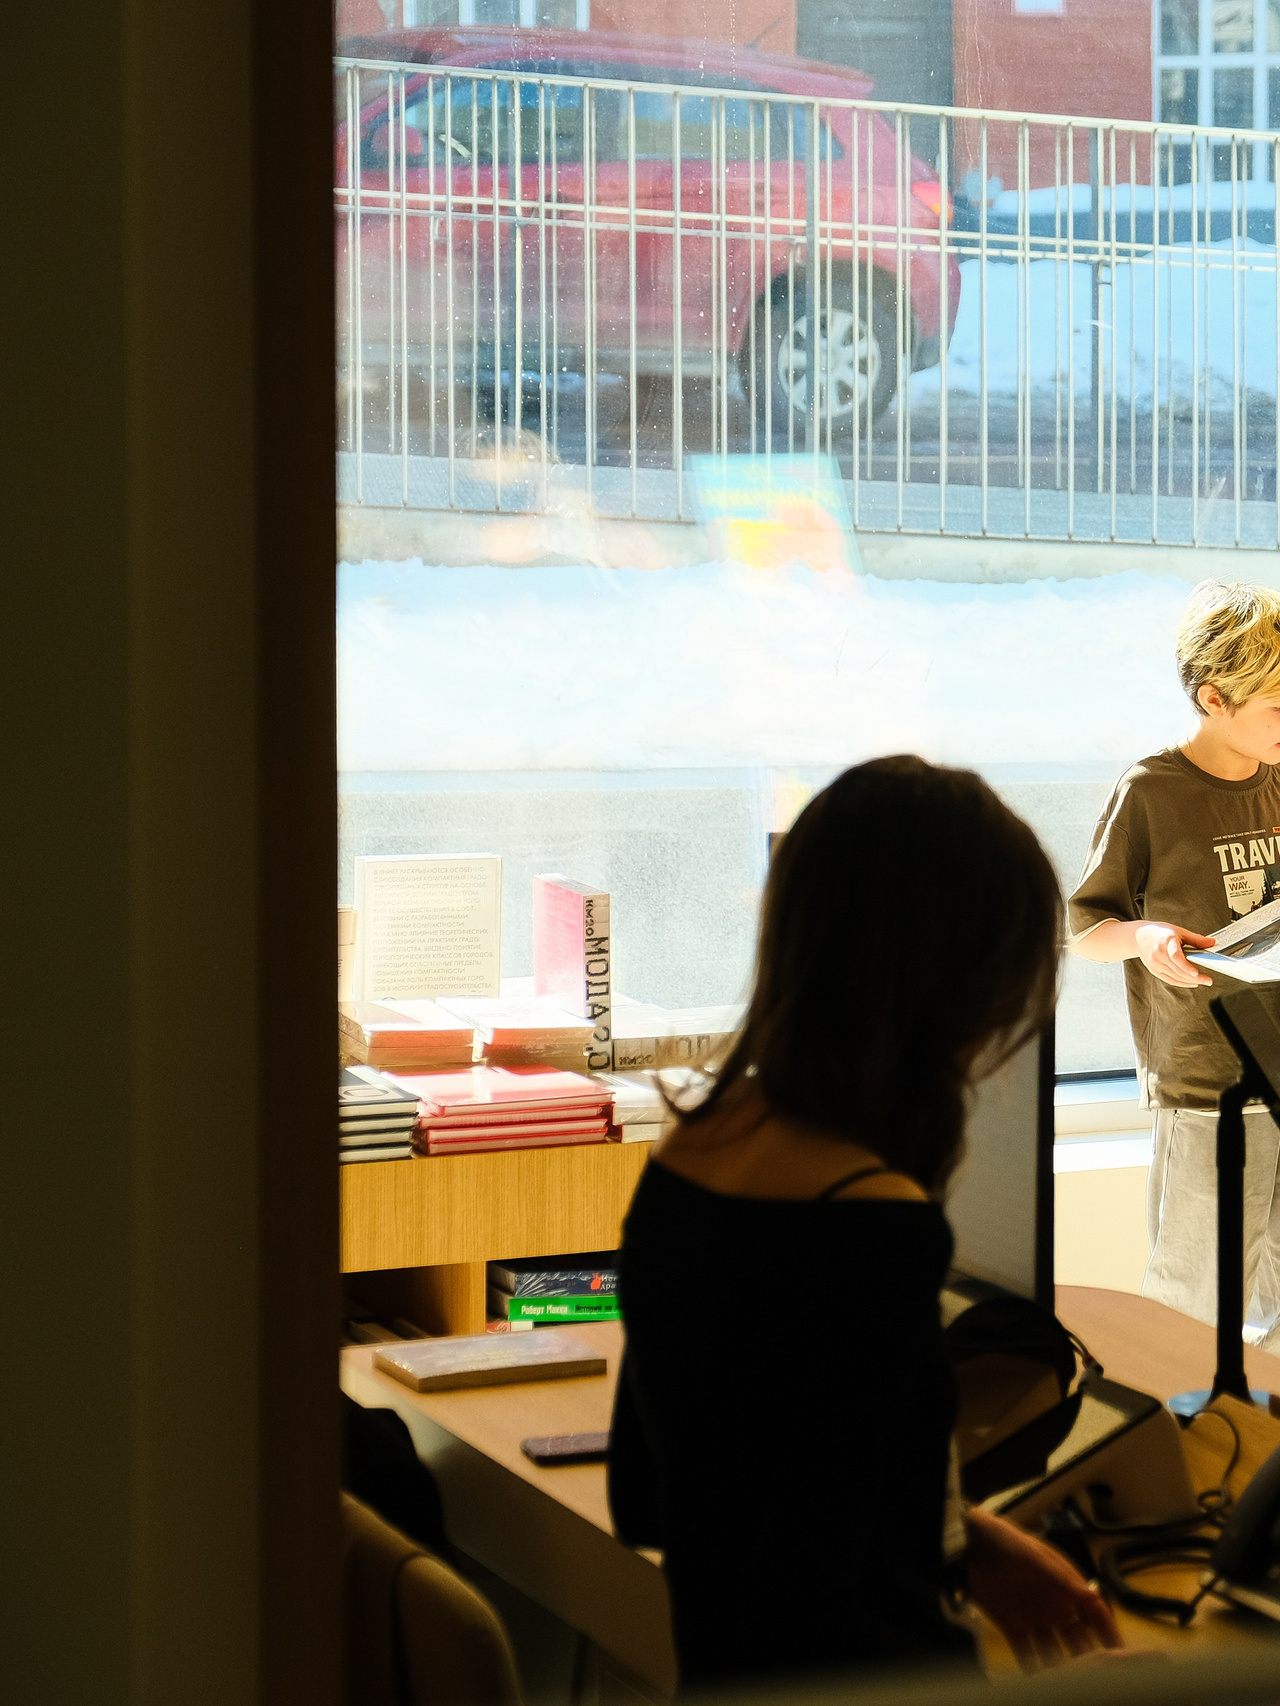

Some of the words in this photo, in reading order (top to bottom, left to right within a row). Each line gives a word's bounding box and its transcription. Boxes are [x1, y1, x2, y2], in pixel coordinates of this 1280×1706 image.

[1228, 881, 1251, 891] WAY.
[585, 936, 609, 1020] МОДА
[521, 1304, 544, 1315] Роберт
[546, 1304, 568, 1314] Макки
